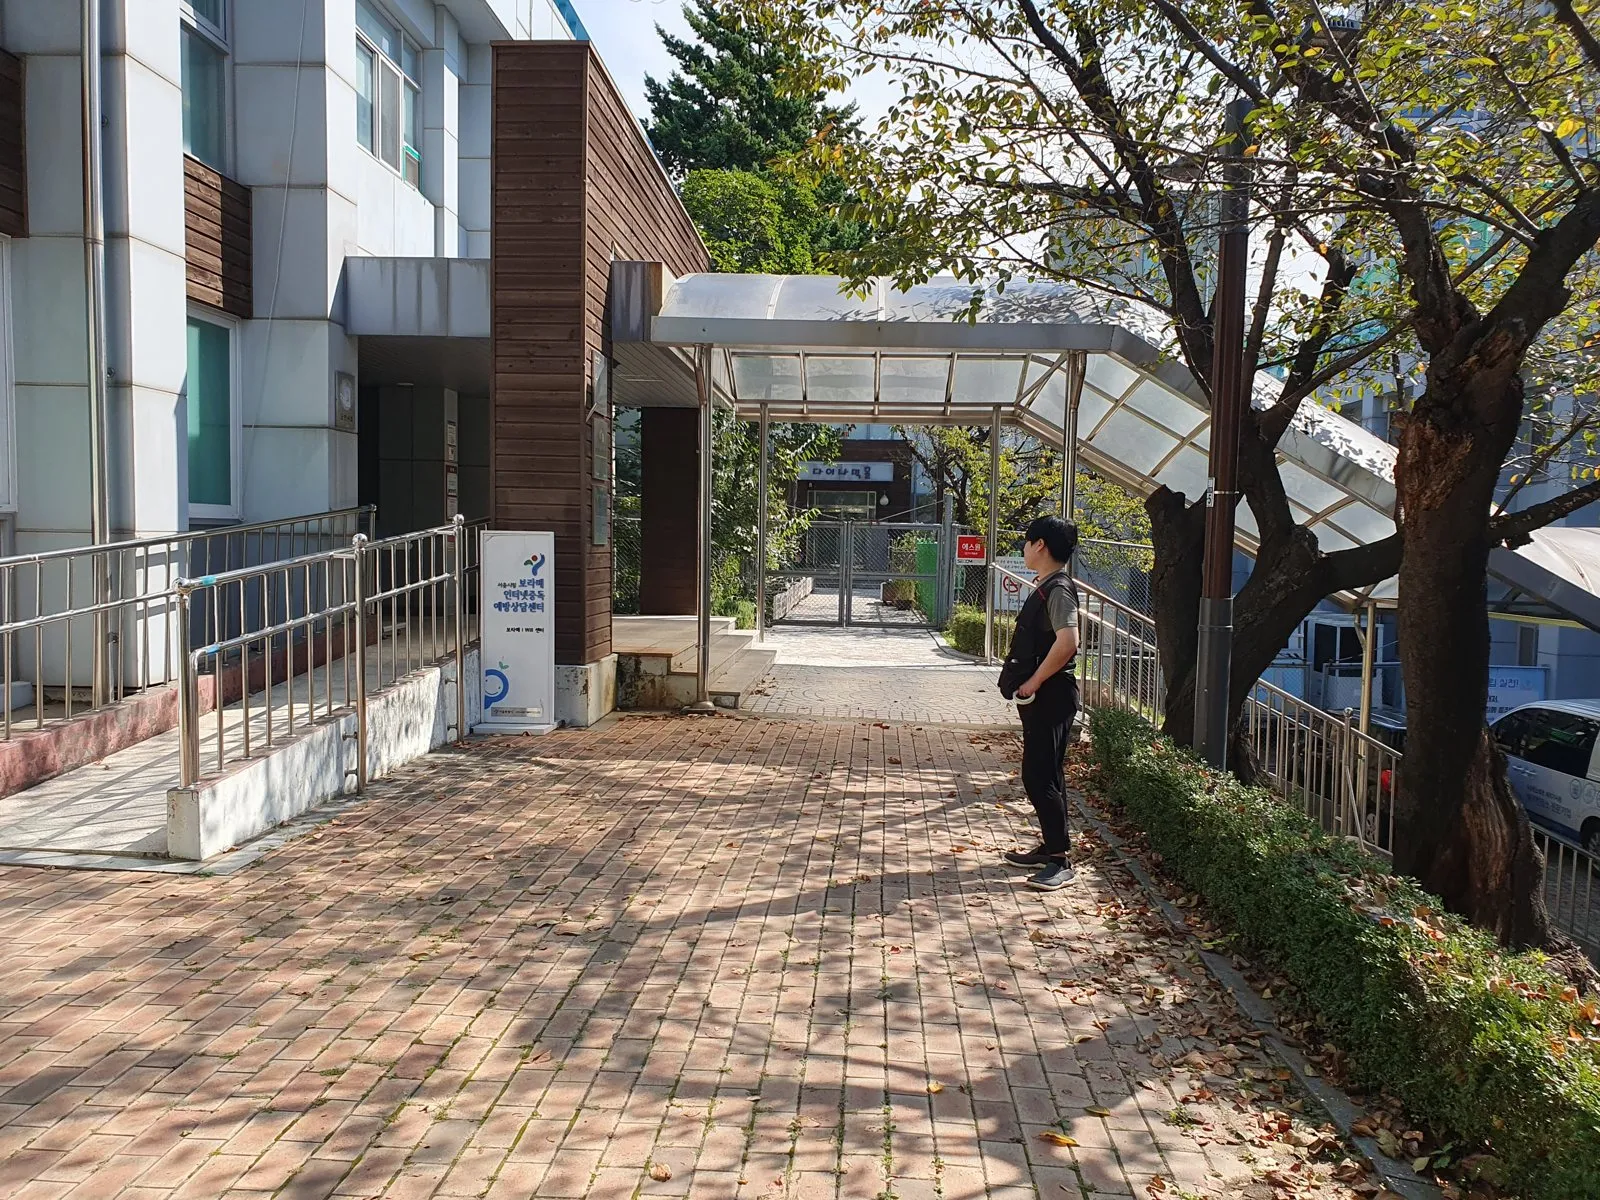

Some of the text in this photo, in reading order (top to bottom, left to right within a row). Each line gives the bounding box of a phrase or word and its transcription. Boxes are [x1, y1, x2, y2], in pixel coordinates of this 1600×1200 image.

[961, 543, 981, 552] 에스원
[518, 578, 544, 589] 보라매
[503, 589, 545, 601] 인터넷중독
[493, 601, 544, 613] 예방상담센터
